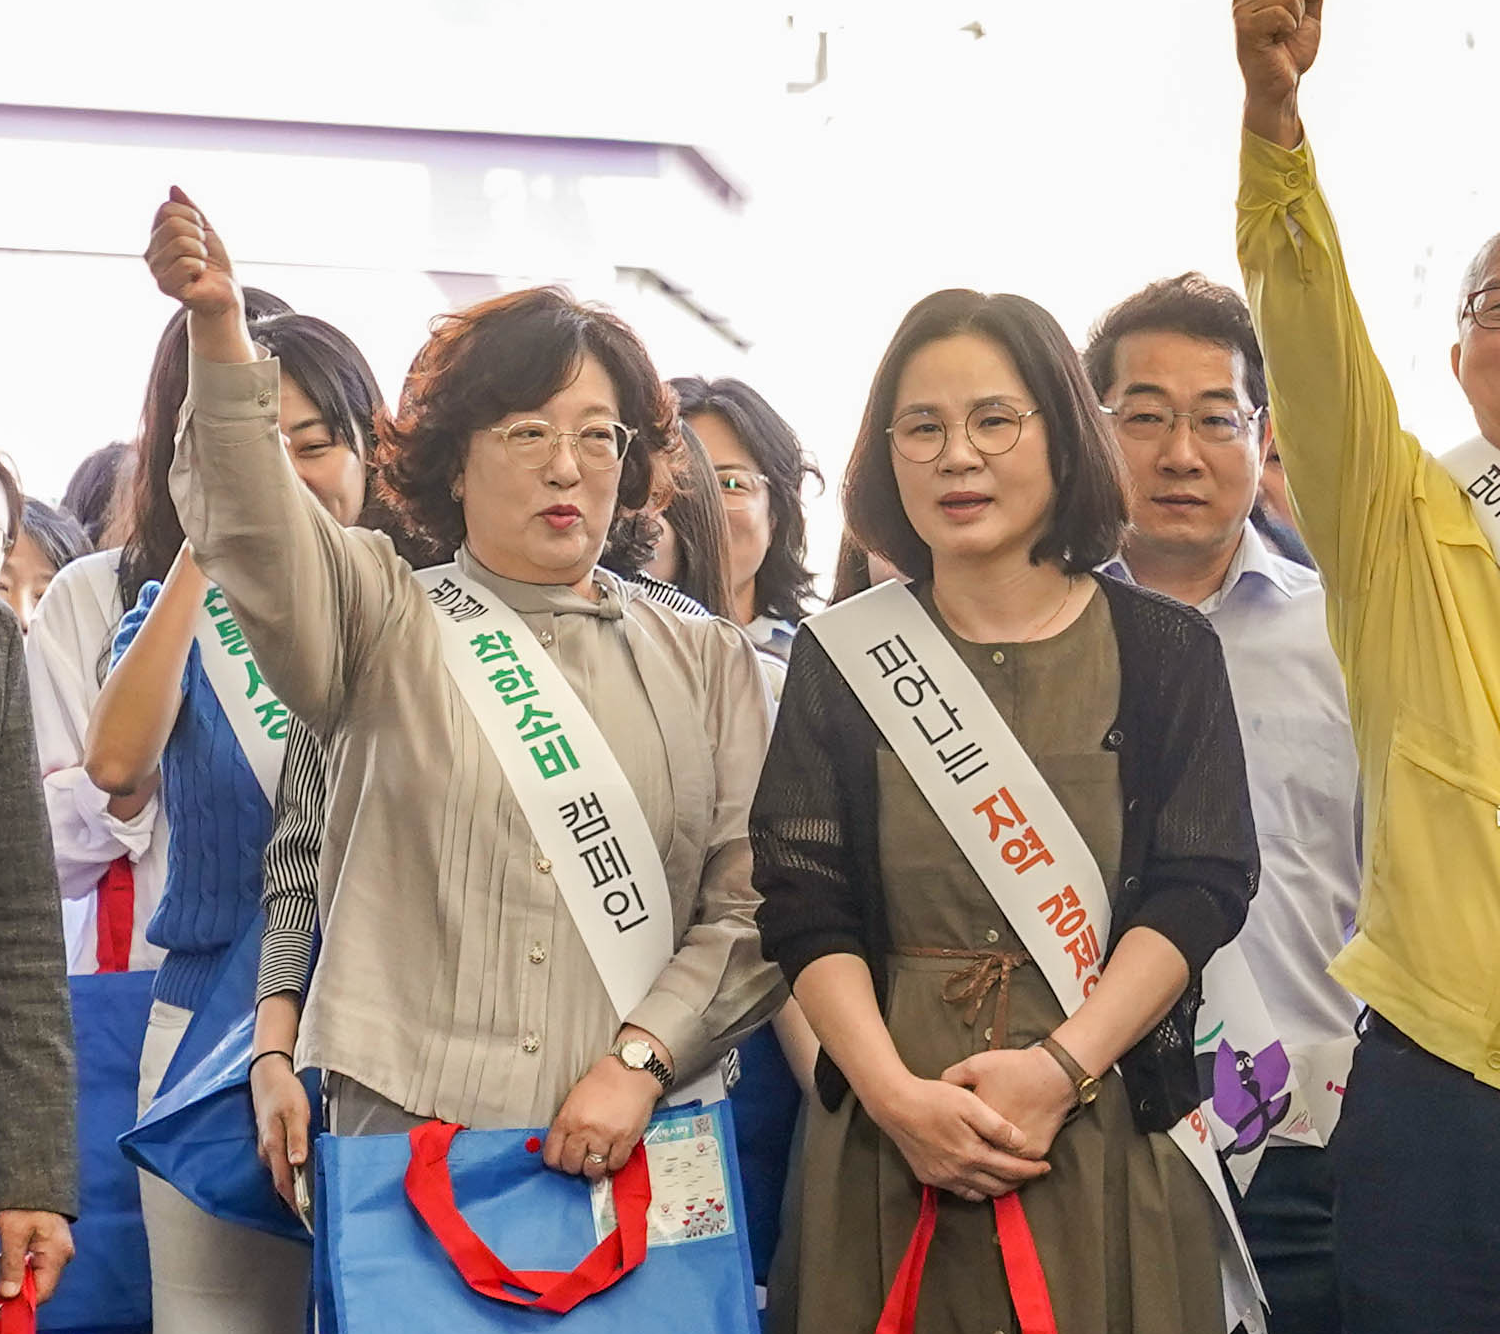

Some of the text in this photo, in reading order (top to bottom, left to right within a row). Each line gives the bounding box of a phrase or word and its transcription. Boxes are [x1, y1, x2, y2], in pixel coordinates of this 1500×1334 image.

[469, 628, 582, 781] 착한소비
[557, 790, 650, 936] 캠페인
[865, 632, 991, 786] 피어나는
[970, 785, 1057, 877] 지역
